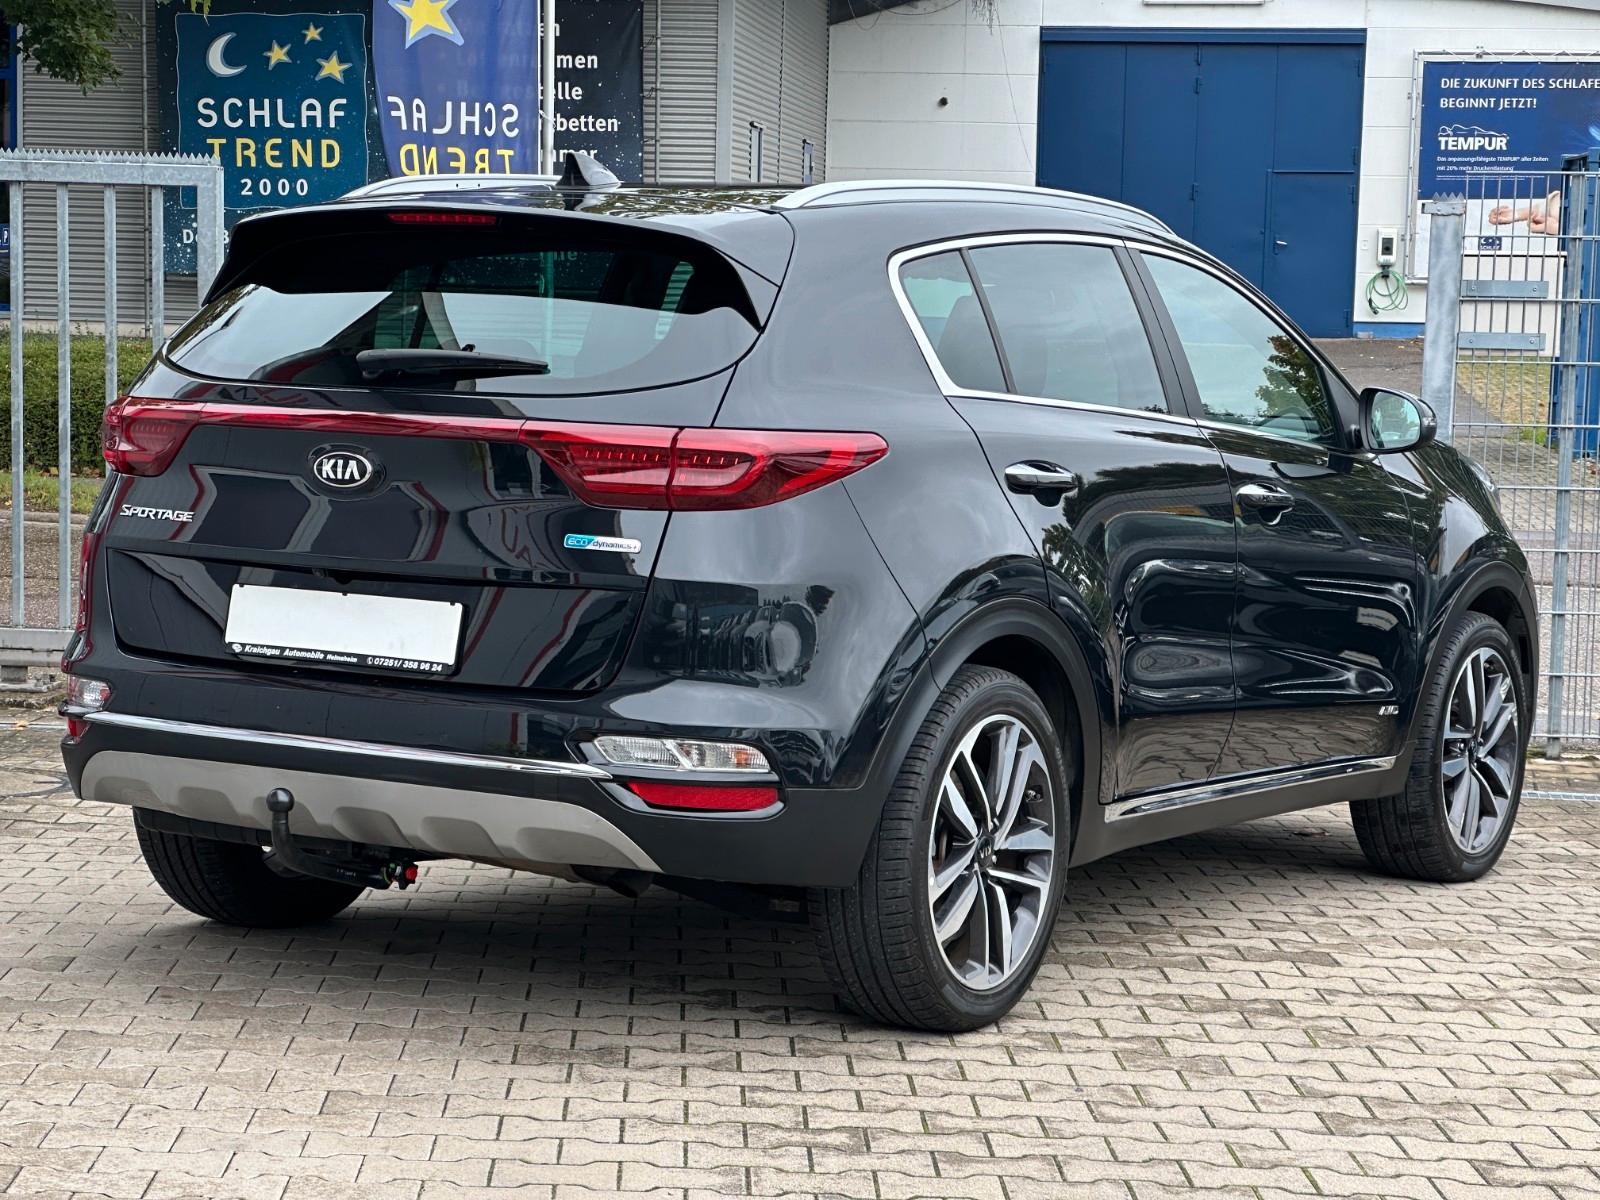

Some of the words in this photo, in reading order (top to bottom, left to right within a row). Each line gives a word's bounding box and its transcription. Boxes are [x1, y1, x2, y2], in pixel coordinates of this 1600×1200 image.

[1440, 78, 1461, 89] DIE
[1464, 78, 1520, 89] ZUKUNFT
[1522, 78, 1545, 89] DES
[197, 97, 348, 128] SCHLAF
[1440, 97, 1495, 109] BEGINNT
[1498, 97, 1537, 110] JETZT!
[1438, 136, 1508, 150] TEMPUR
[206, 137, 341, 168] TREND
[240, 178, 309, 196] 2000
[321, 458, 361, 480] KIA
[119, 504, 195, 522] SPORTAGE
[244, 644, 280, 656] Kraichgau
[283, 648, 325, 659] Automobile
[402, 660, 418, 669] 358
[431, 663, 443, 672] 24
